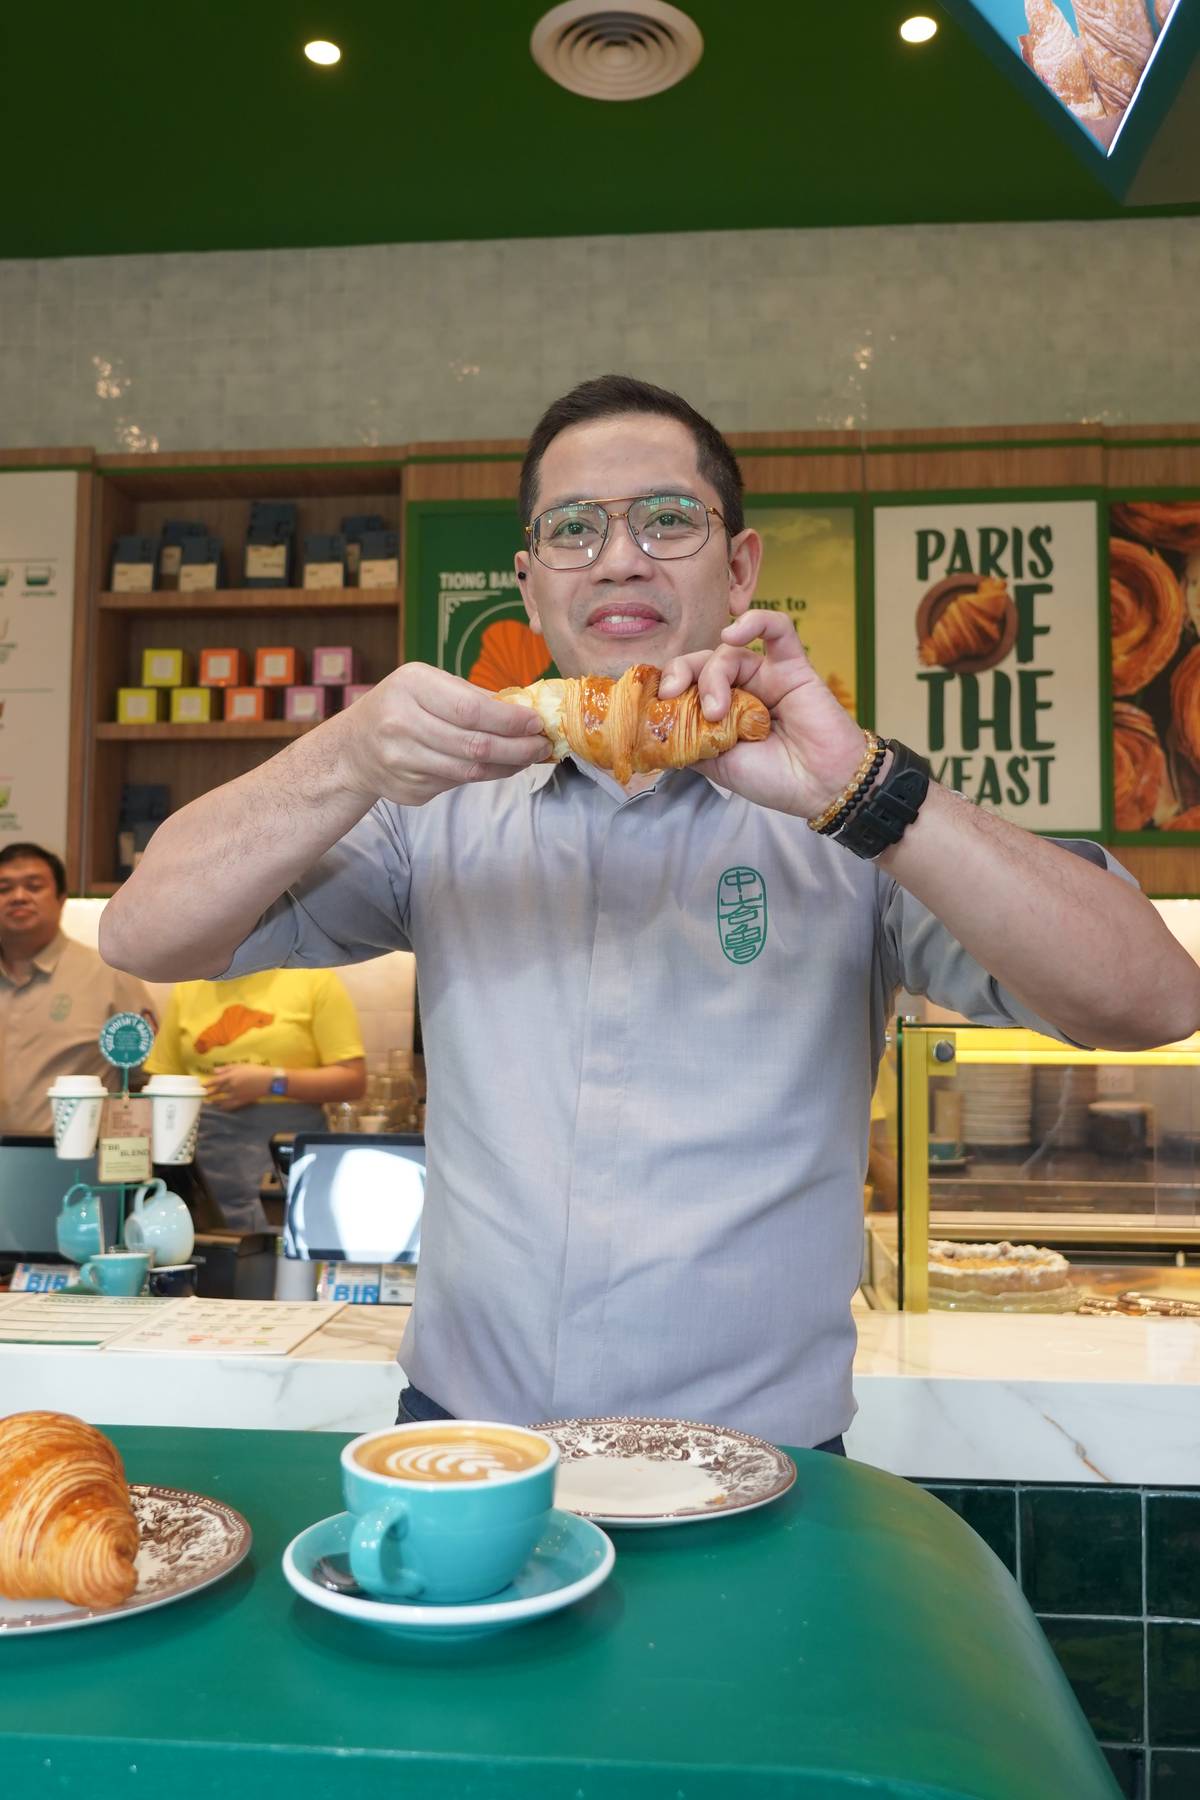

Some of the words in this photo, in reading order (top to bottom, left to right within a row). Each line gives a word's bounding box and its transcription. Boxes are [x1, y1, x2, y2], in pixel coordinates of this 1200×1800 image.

[915, 525, 1054, 581] PARIS
[439, 571, 487, 589] TIONG
[786, 597, 806, 611] to
[916, 669, 1055, 752] THE
[26, 1272, 69, 1292] BIR
[334, 1284, 379, 1304] BIR
